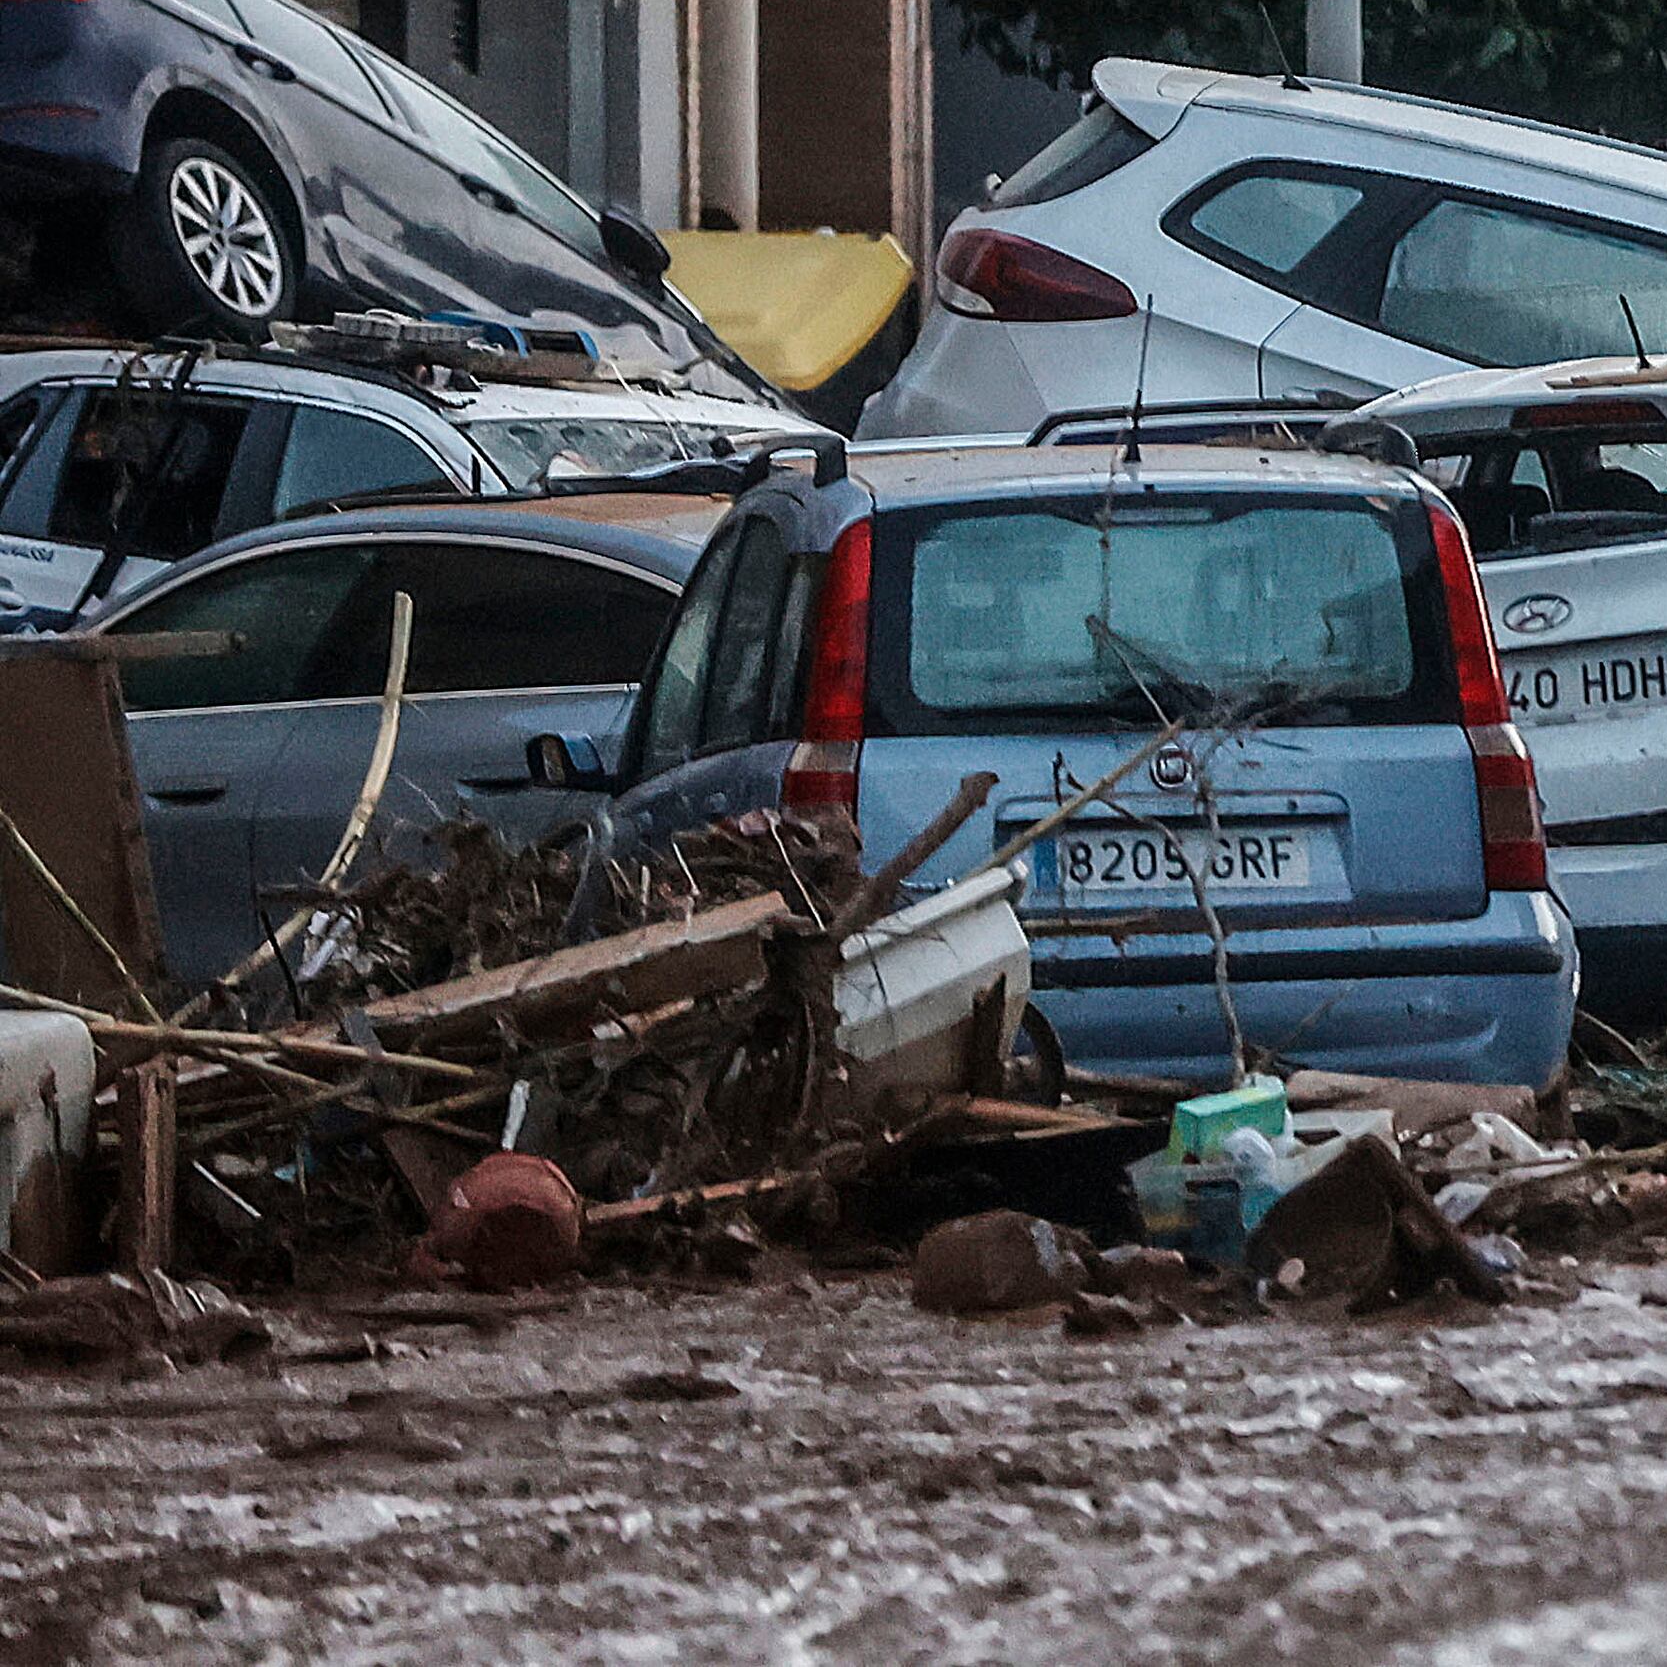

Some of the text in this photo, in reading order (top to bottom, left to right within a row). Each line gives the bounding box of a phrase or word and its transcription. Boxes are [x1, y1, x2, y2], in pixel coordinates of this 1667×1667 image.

[1508, 654, 1667, 712] 40 HDH
[1068, 835, 1294, 884] 8205 GRF
